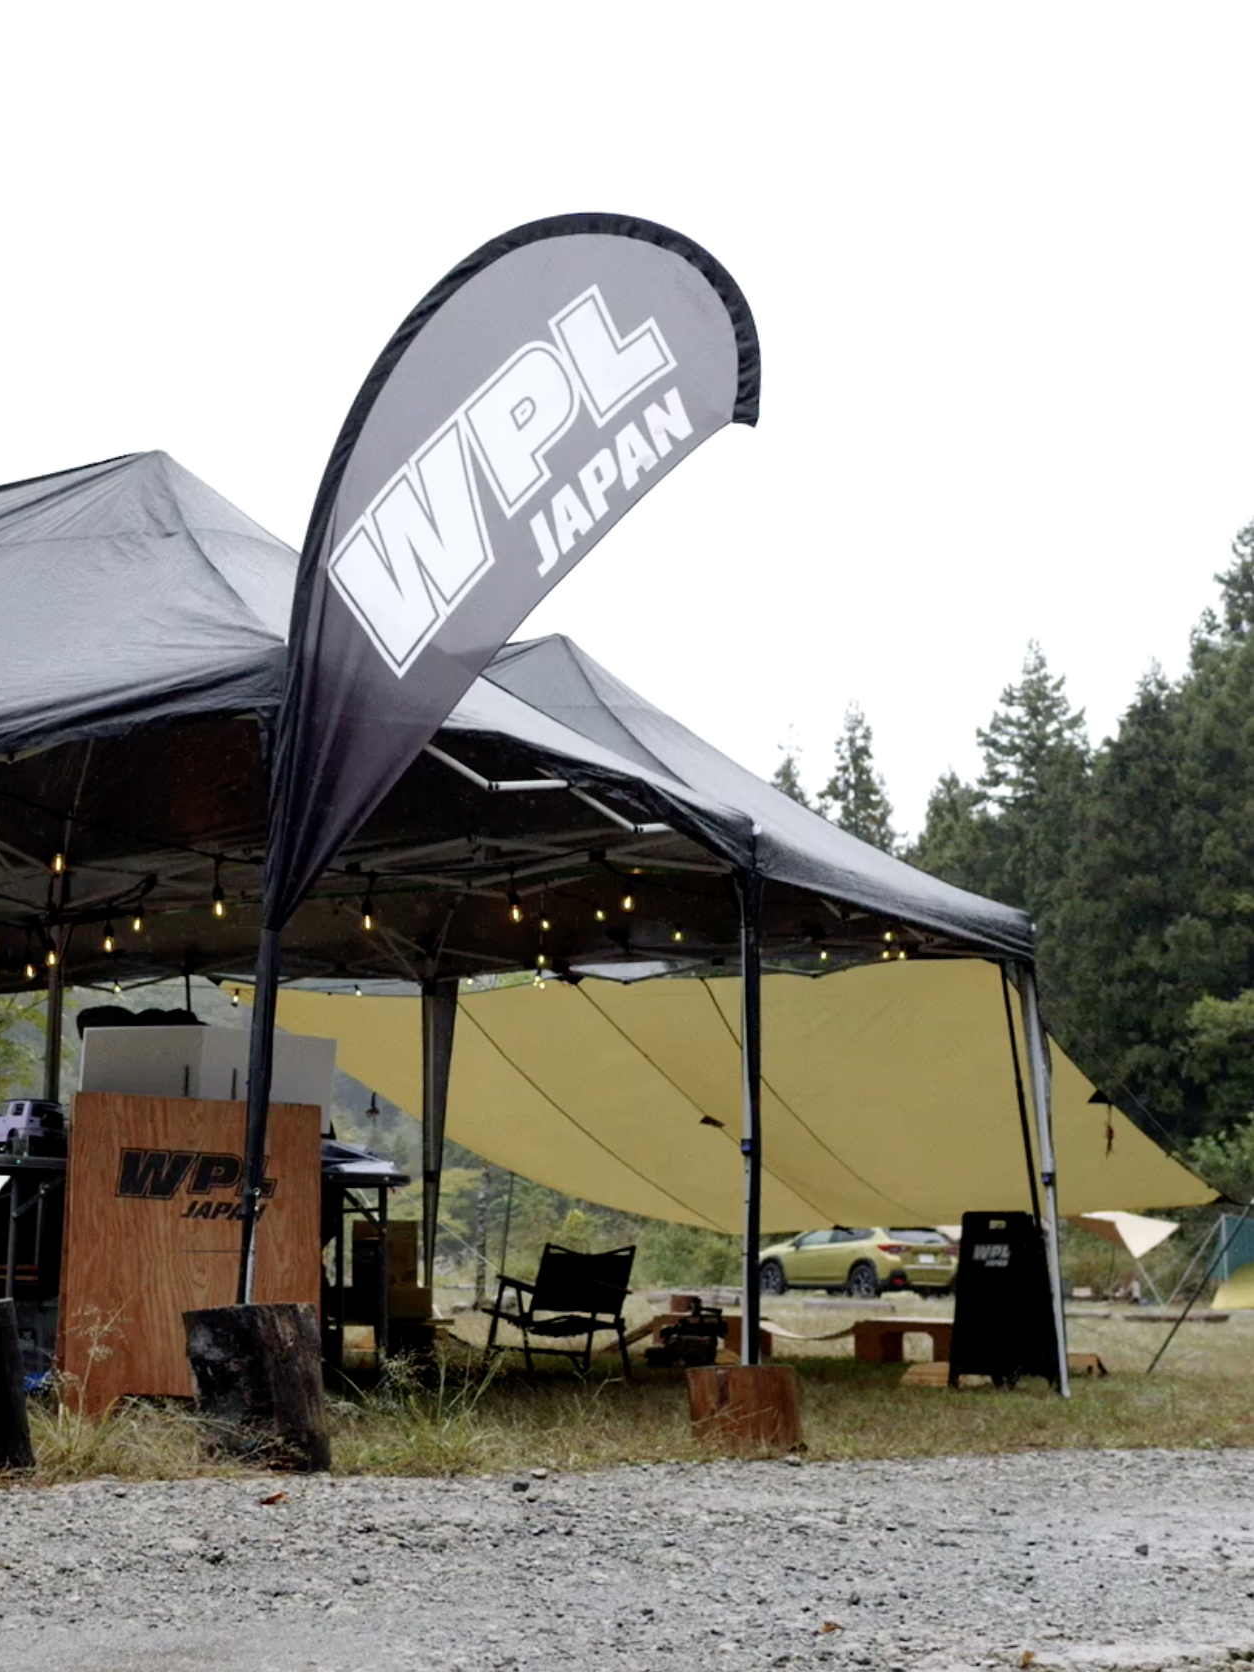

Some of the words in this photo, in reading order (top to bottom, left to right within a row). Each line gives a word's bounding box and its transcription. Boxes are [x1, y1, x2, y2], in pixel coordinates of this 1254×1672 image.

[327, 283, 678, 679] WPL
[528, 386, 694, 578] JAPAN
[972, 1244, 1011, 1261] WPL
